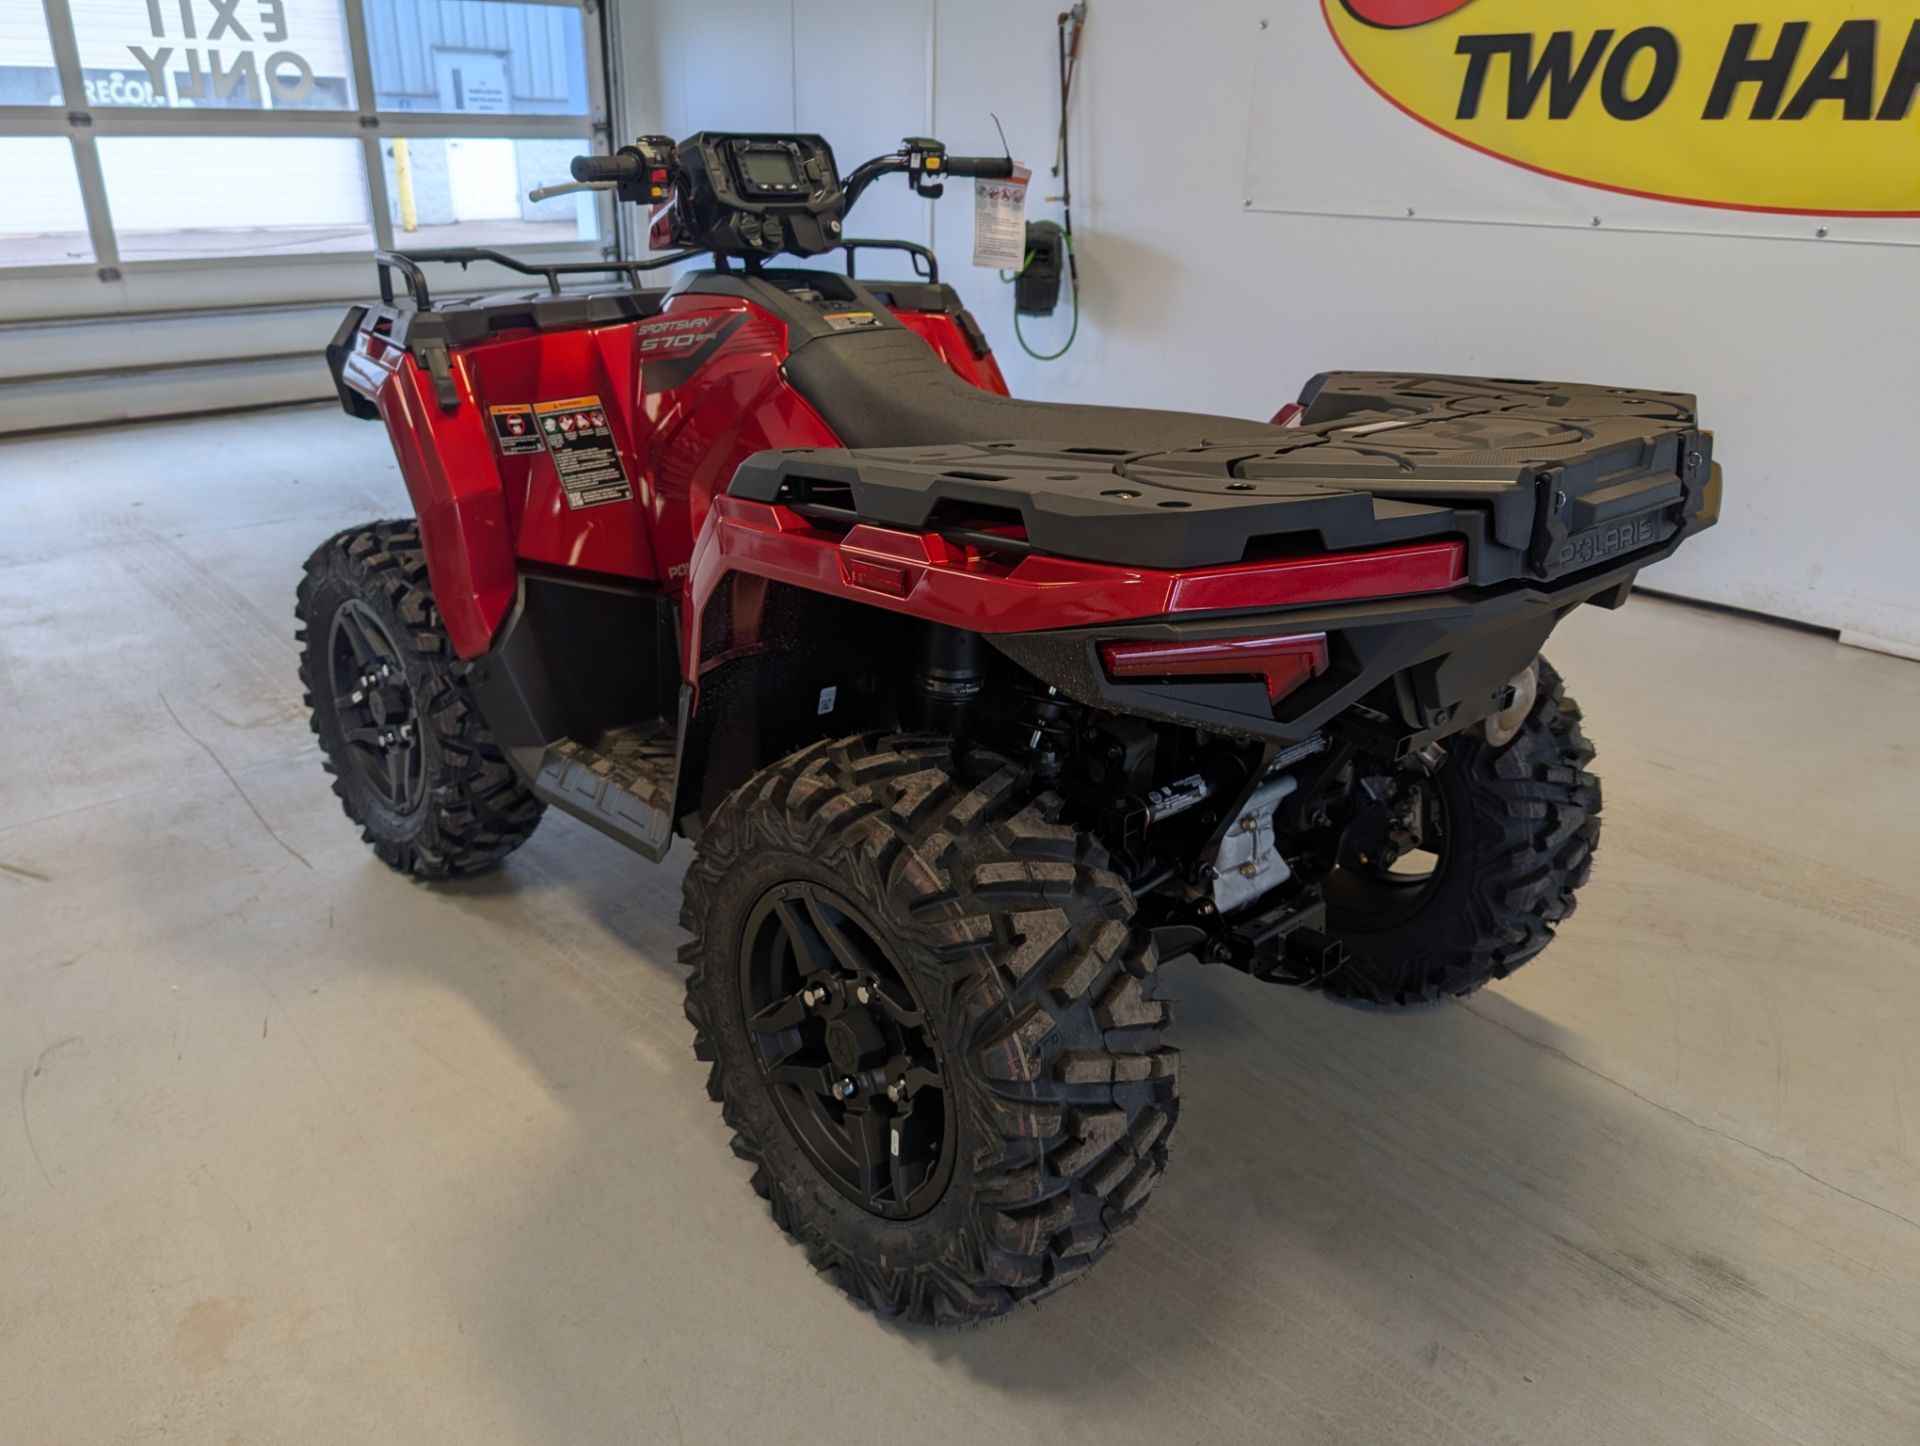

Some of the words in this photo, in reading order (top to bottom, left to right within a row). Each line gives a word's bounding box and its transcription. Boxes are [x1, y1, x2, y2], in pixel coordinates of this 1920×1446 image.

[1454, 26, 1681, 121] TWO
[638, 315, 712, 336] SPORTSMAN
[640, 333, 694, 351] 570
[1560, 519, 1653, 564] POLARIS
